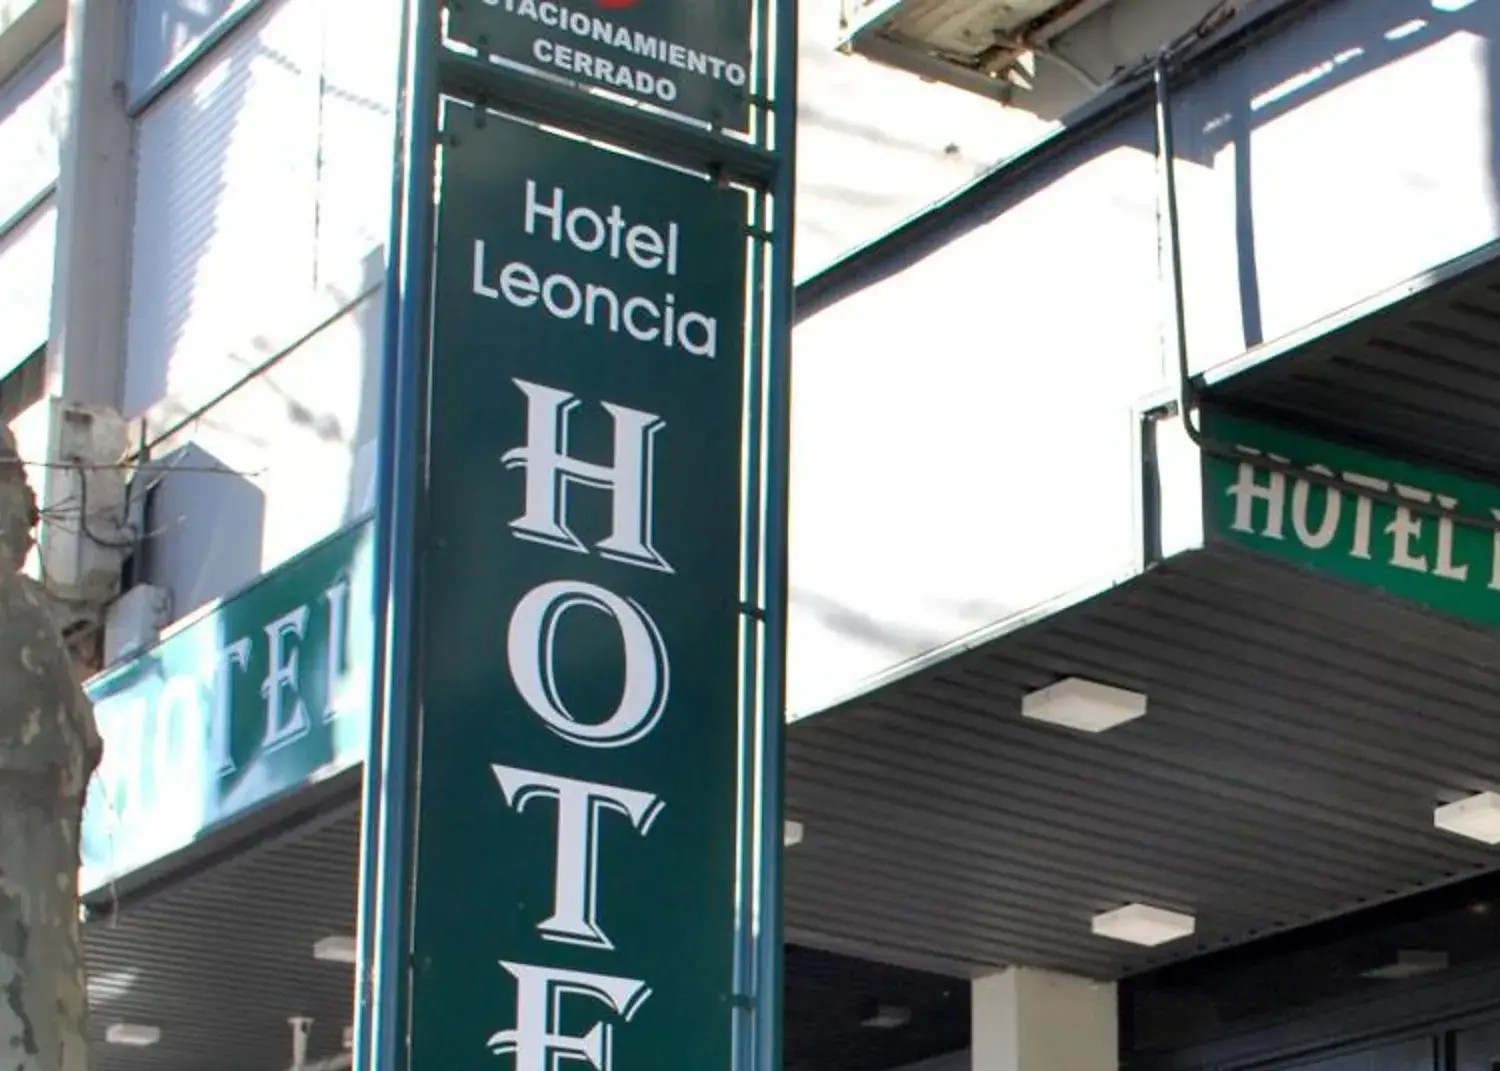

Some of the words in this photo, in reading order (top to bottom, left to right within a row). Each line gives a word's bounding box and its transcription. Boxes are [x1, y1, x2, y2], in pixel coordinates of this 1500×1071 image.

[482, 0, 746, 87] TACIONAMIENTO
[532, 37, 677, 102] CERRADO
[523, 178, 678, 276] Hotel
[472, 239, 718, 359] Leoncia
[1225, 444, 1469, 582] HOTEL
